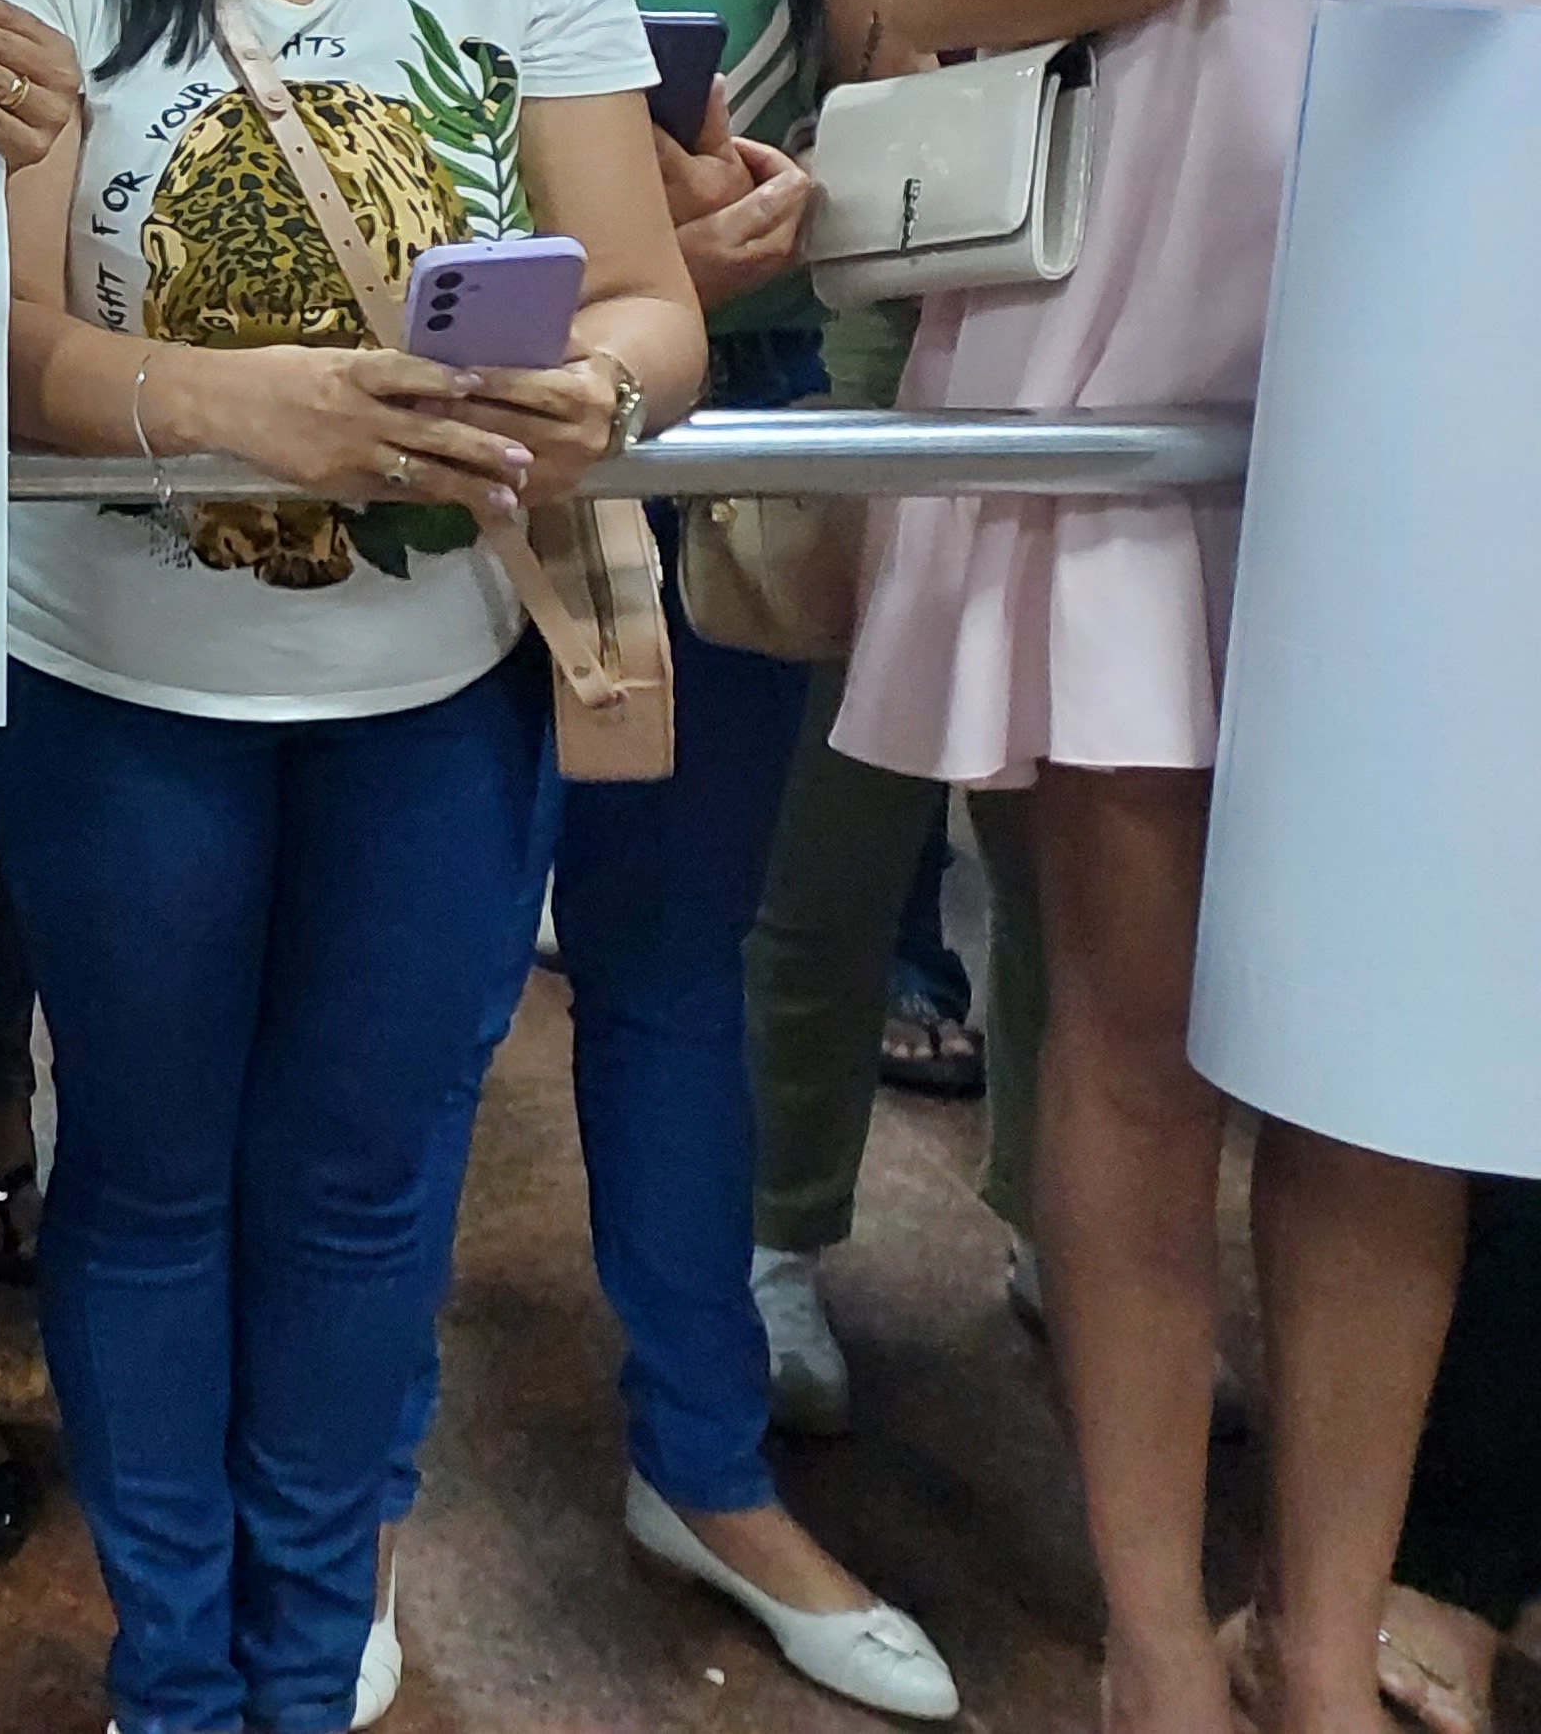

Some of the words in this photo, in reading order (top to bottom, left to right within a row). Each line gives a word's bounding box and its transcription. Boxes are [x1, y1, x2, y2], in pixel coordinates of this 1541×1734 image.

[281, 31, 347, 60] HTS
[145, 82, 223, 142] YOUR
[91, 171, 154, 235] FOR
[96, 260, 130, 333] IGHT
